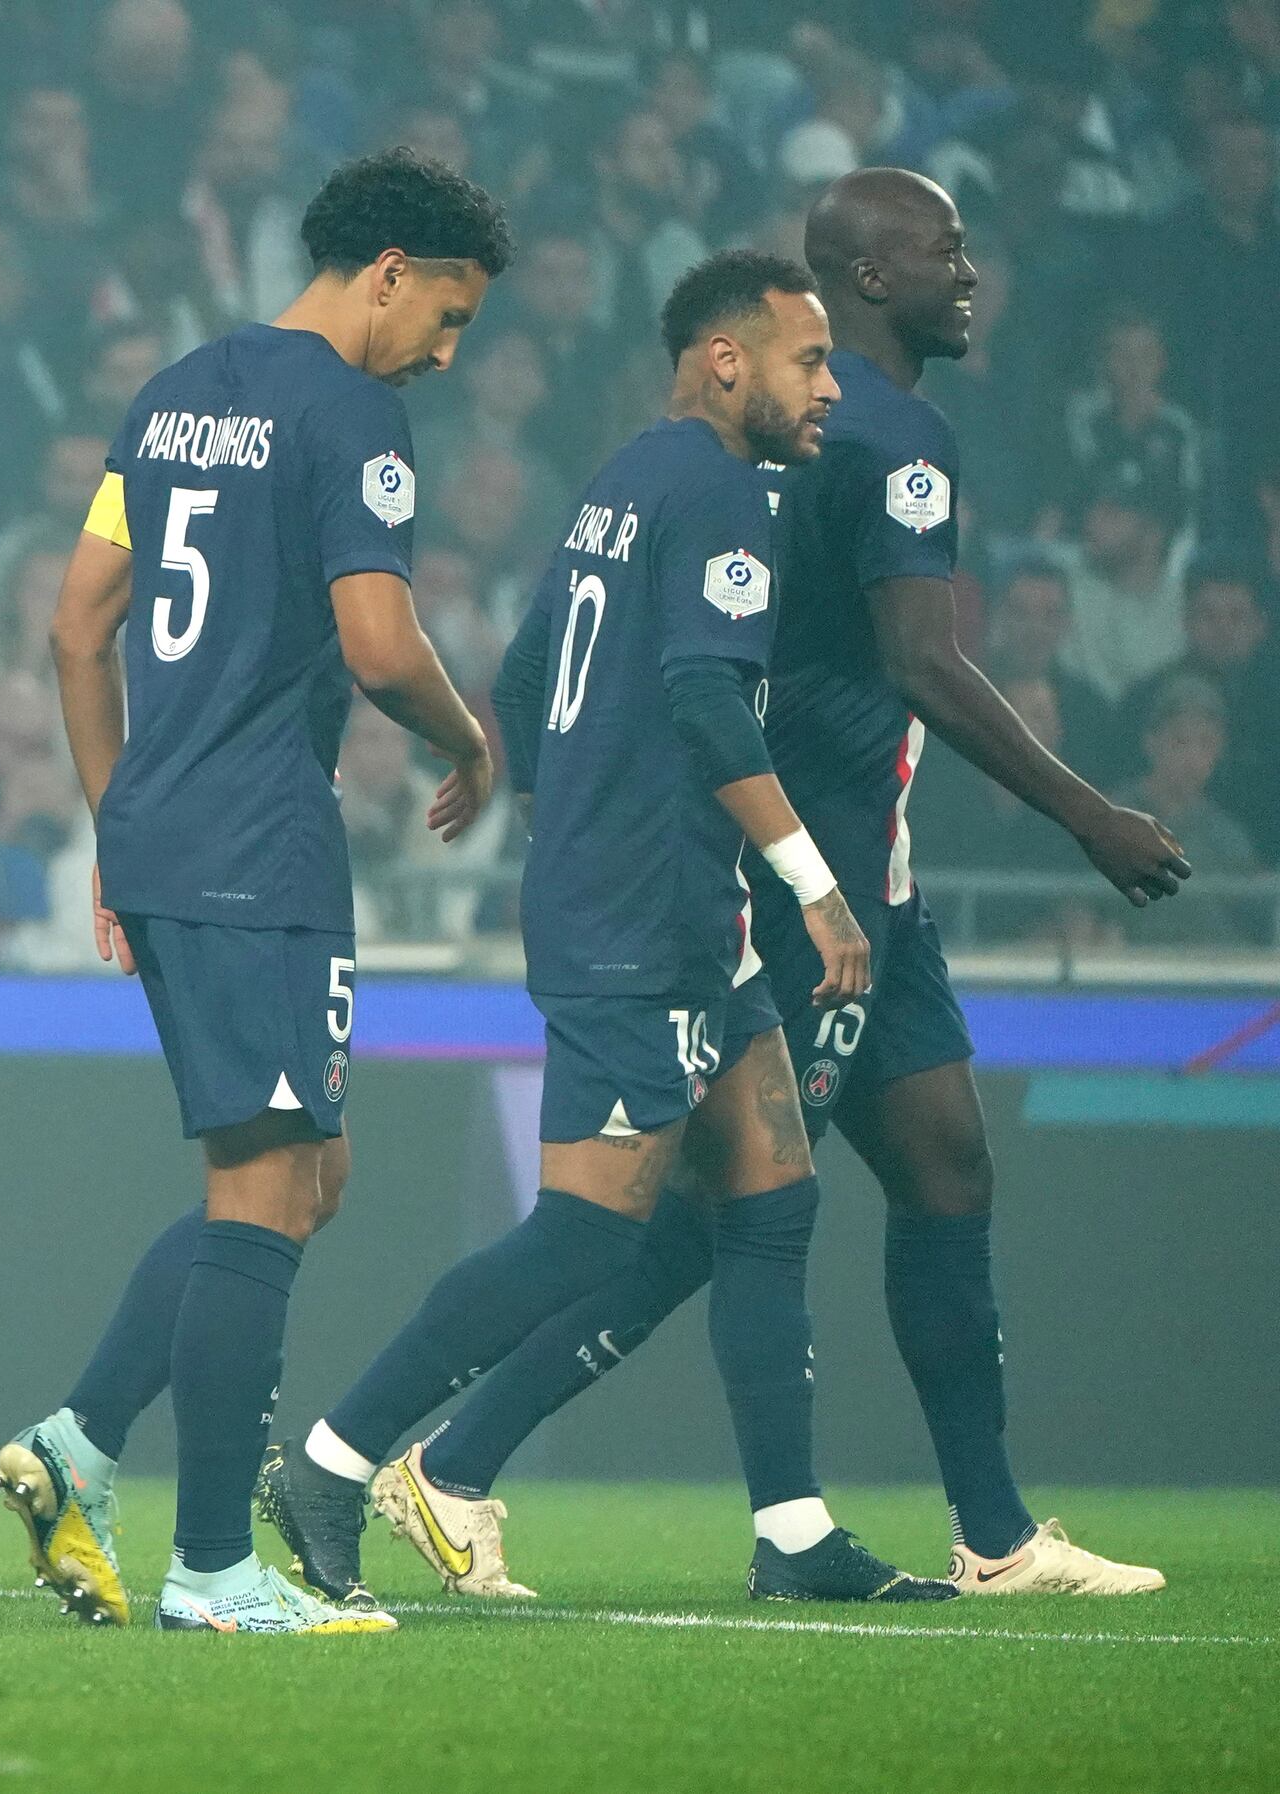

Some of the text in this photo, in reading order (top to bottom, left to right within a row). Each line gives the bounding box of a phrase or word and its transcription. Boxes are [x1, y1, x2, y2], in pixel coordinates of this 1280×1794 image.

[151, 486, 219, 662] 5
[723, 587, 746, 596] LIGUE
[547, 569, 607, 734] 10
[326, 956, 356, 1044] 5
[668, 1009, 720, 1075] 10
